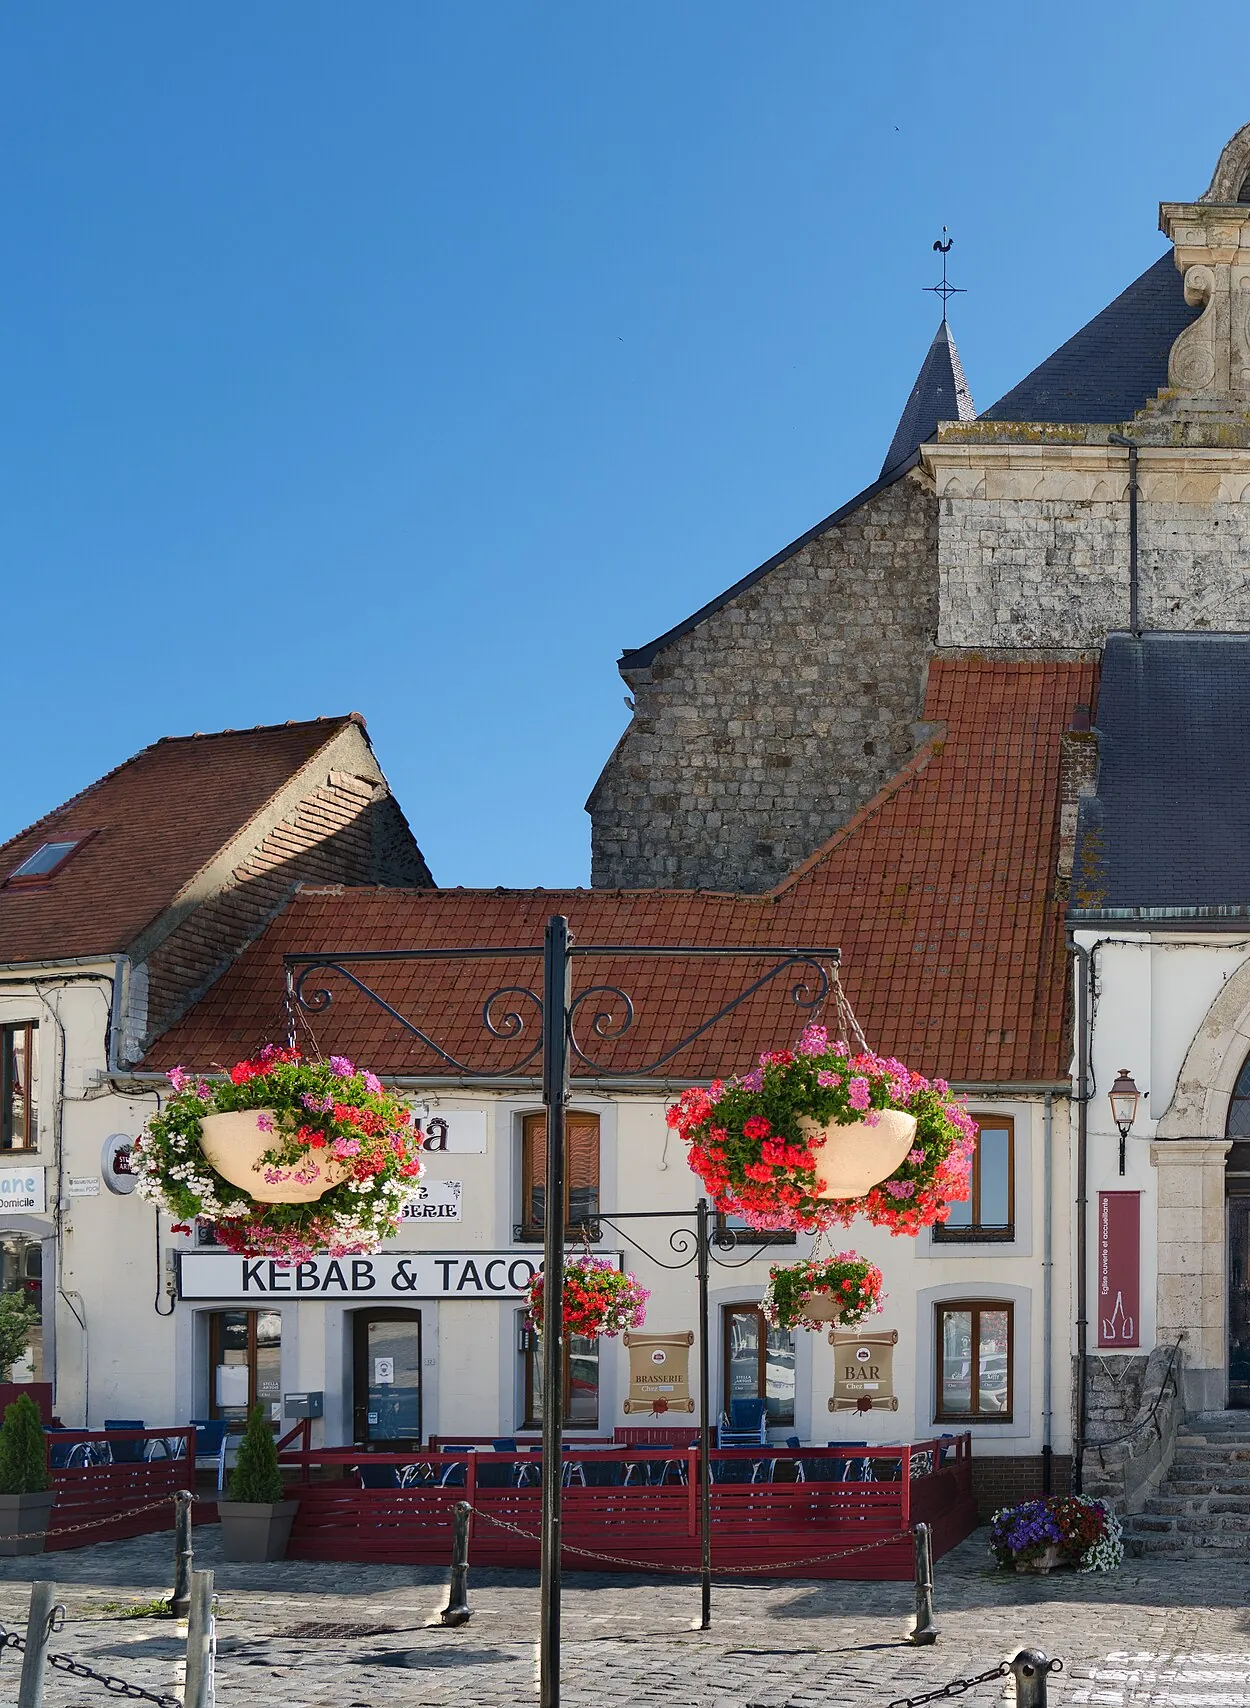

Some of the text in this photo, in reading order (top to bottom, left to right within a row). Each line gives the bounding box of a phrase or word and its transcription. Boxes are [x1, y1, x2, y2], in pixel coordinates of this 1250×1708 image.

[242, 1259, 548, 1292] KEBAB & TACO
[636, 1374, 684, 1383] BRASSERIE
[844, 1366, 880, 1380] BAR
[846, 1382, 862, 1390] Chez
